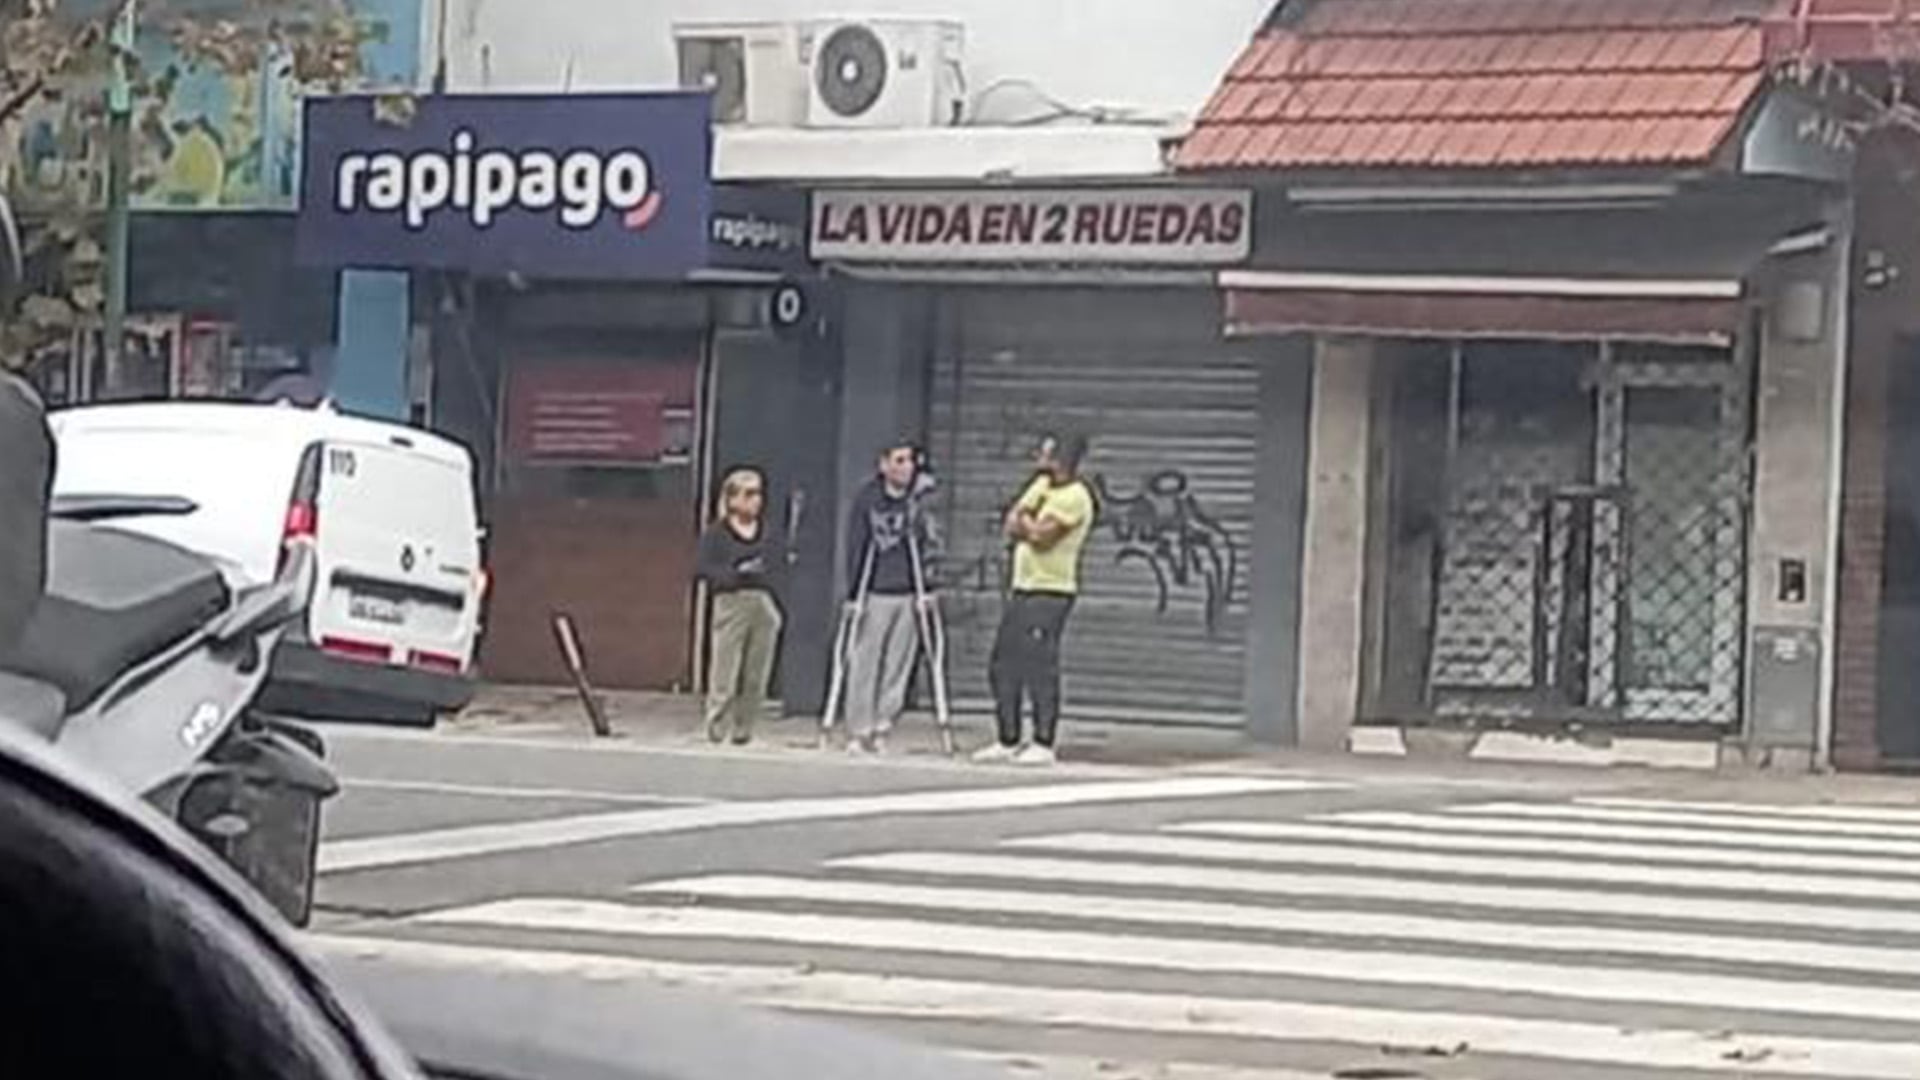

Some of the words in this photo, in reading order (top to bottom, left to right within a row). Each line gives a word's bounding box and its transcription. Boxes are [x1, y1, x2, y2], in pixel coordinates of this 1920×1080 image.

[338, 131, 650, 227] rapipago
[819, 203, 868, 243] LA
[878, 203, 972, 244] VIDA
[977, 204, 1038, 244] EN
[1041, 204, 1069, 244] 2
[1073, 203, 1244, 245] RUEDAS
